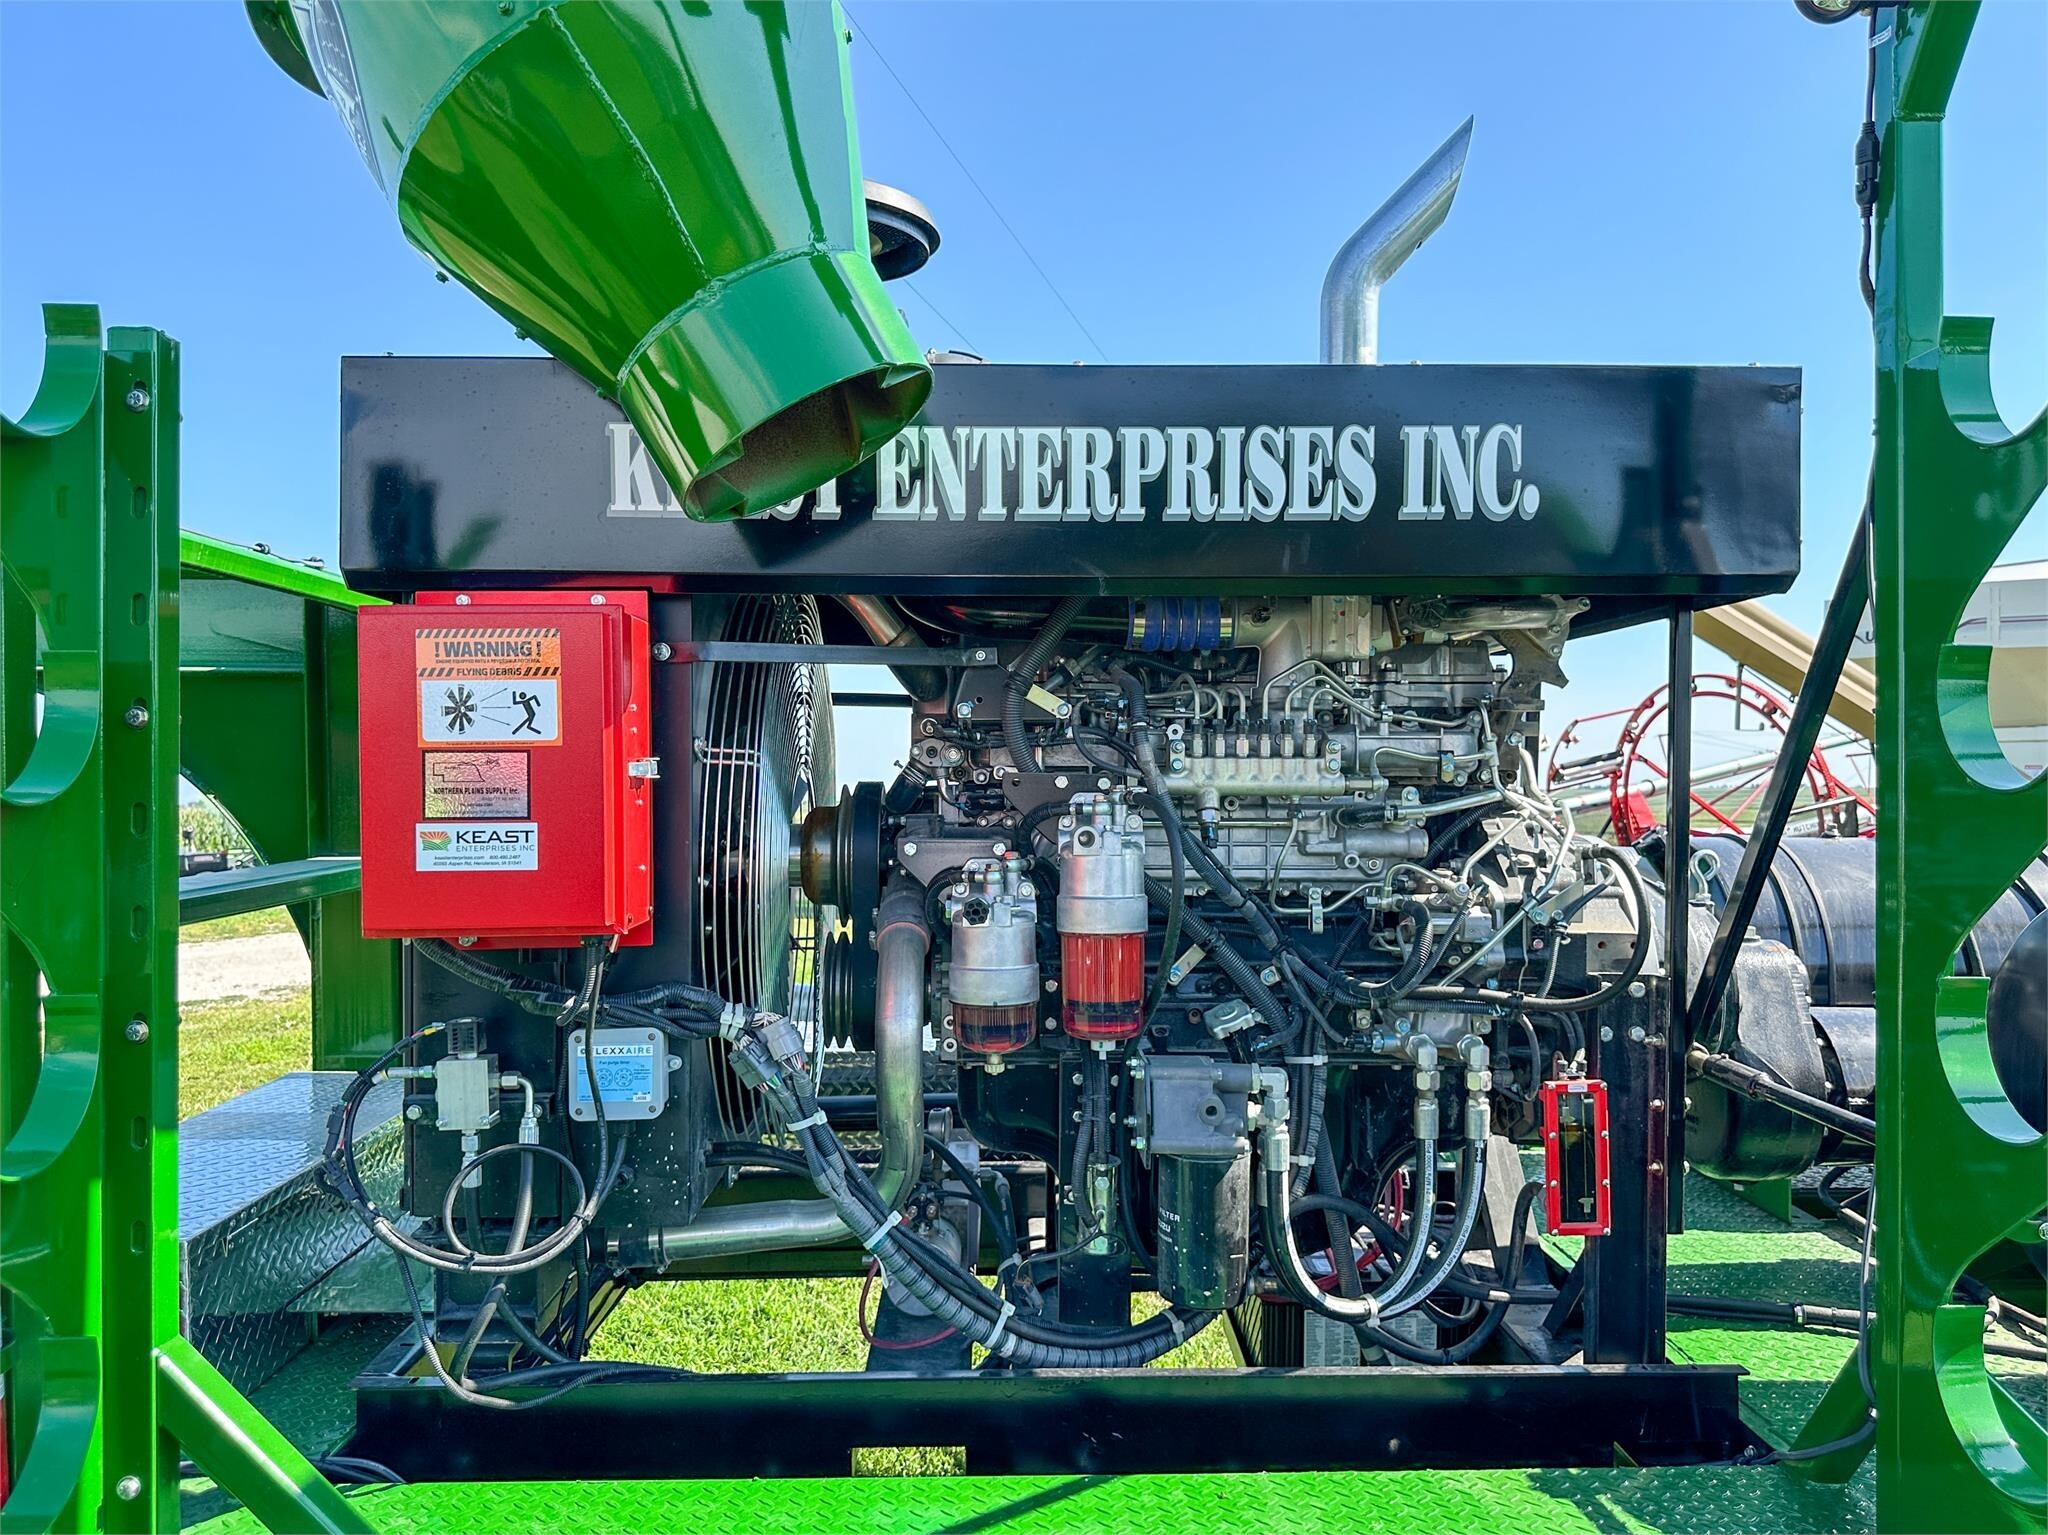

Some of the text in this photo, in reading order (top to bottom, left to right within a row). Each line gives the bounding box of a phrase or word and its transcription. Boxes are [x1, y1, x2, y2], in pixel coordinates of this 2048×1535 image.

[872, 424, 1377, 523] ENTERPRISES
[1398, 422, 1540, 522] INC.
[443, 641, 532, 658] WARNING
[457, 667, 522, 677] FLYING DEBRIS
[433, 787, 463, 795] NORTHERN
[464, 787, 484, 795] PLAINS
[485, 787, 509, 796] SUPPLY,
[456, 830, 535, 844] KEAST
[592, 1046, 652, 1055] LEXXAIRE
